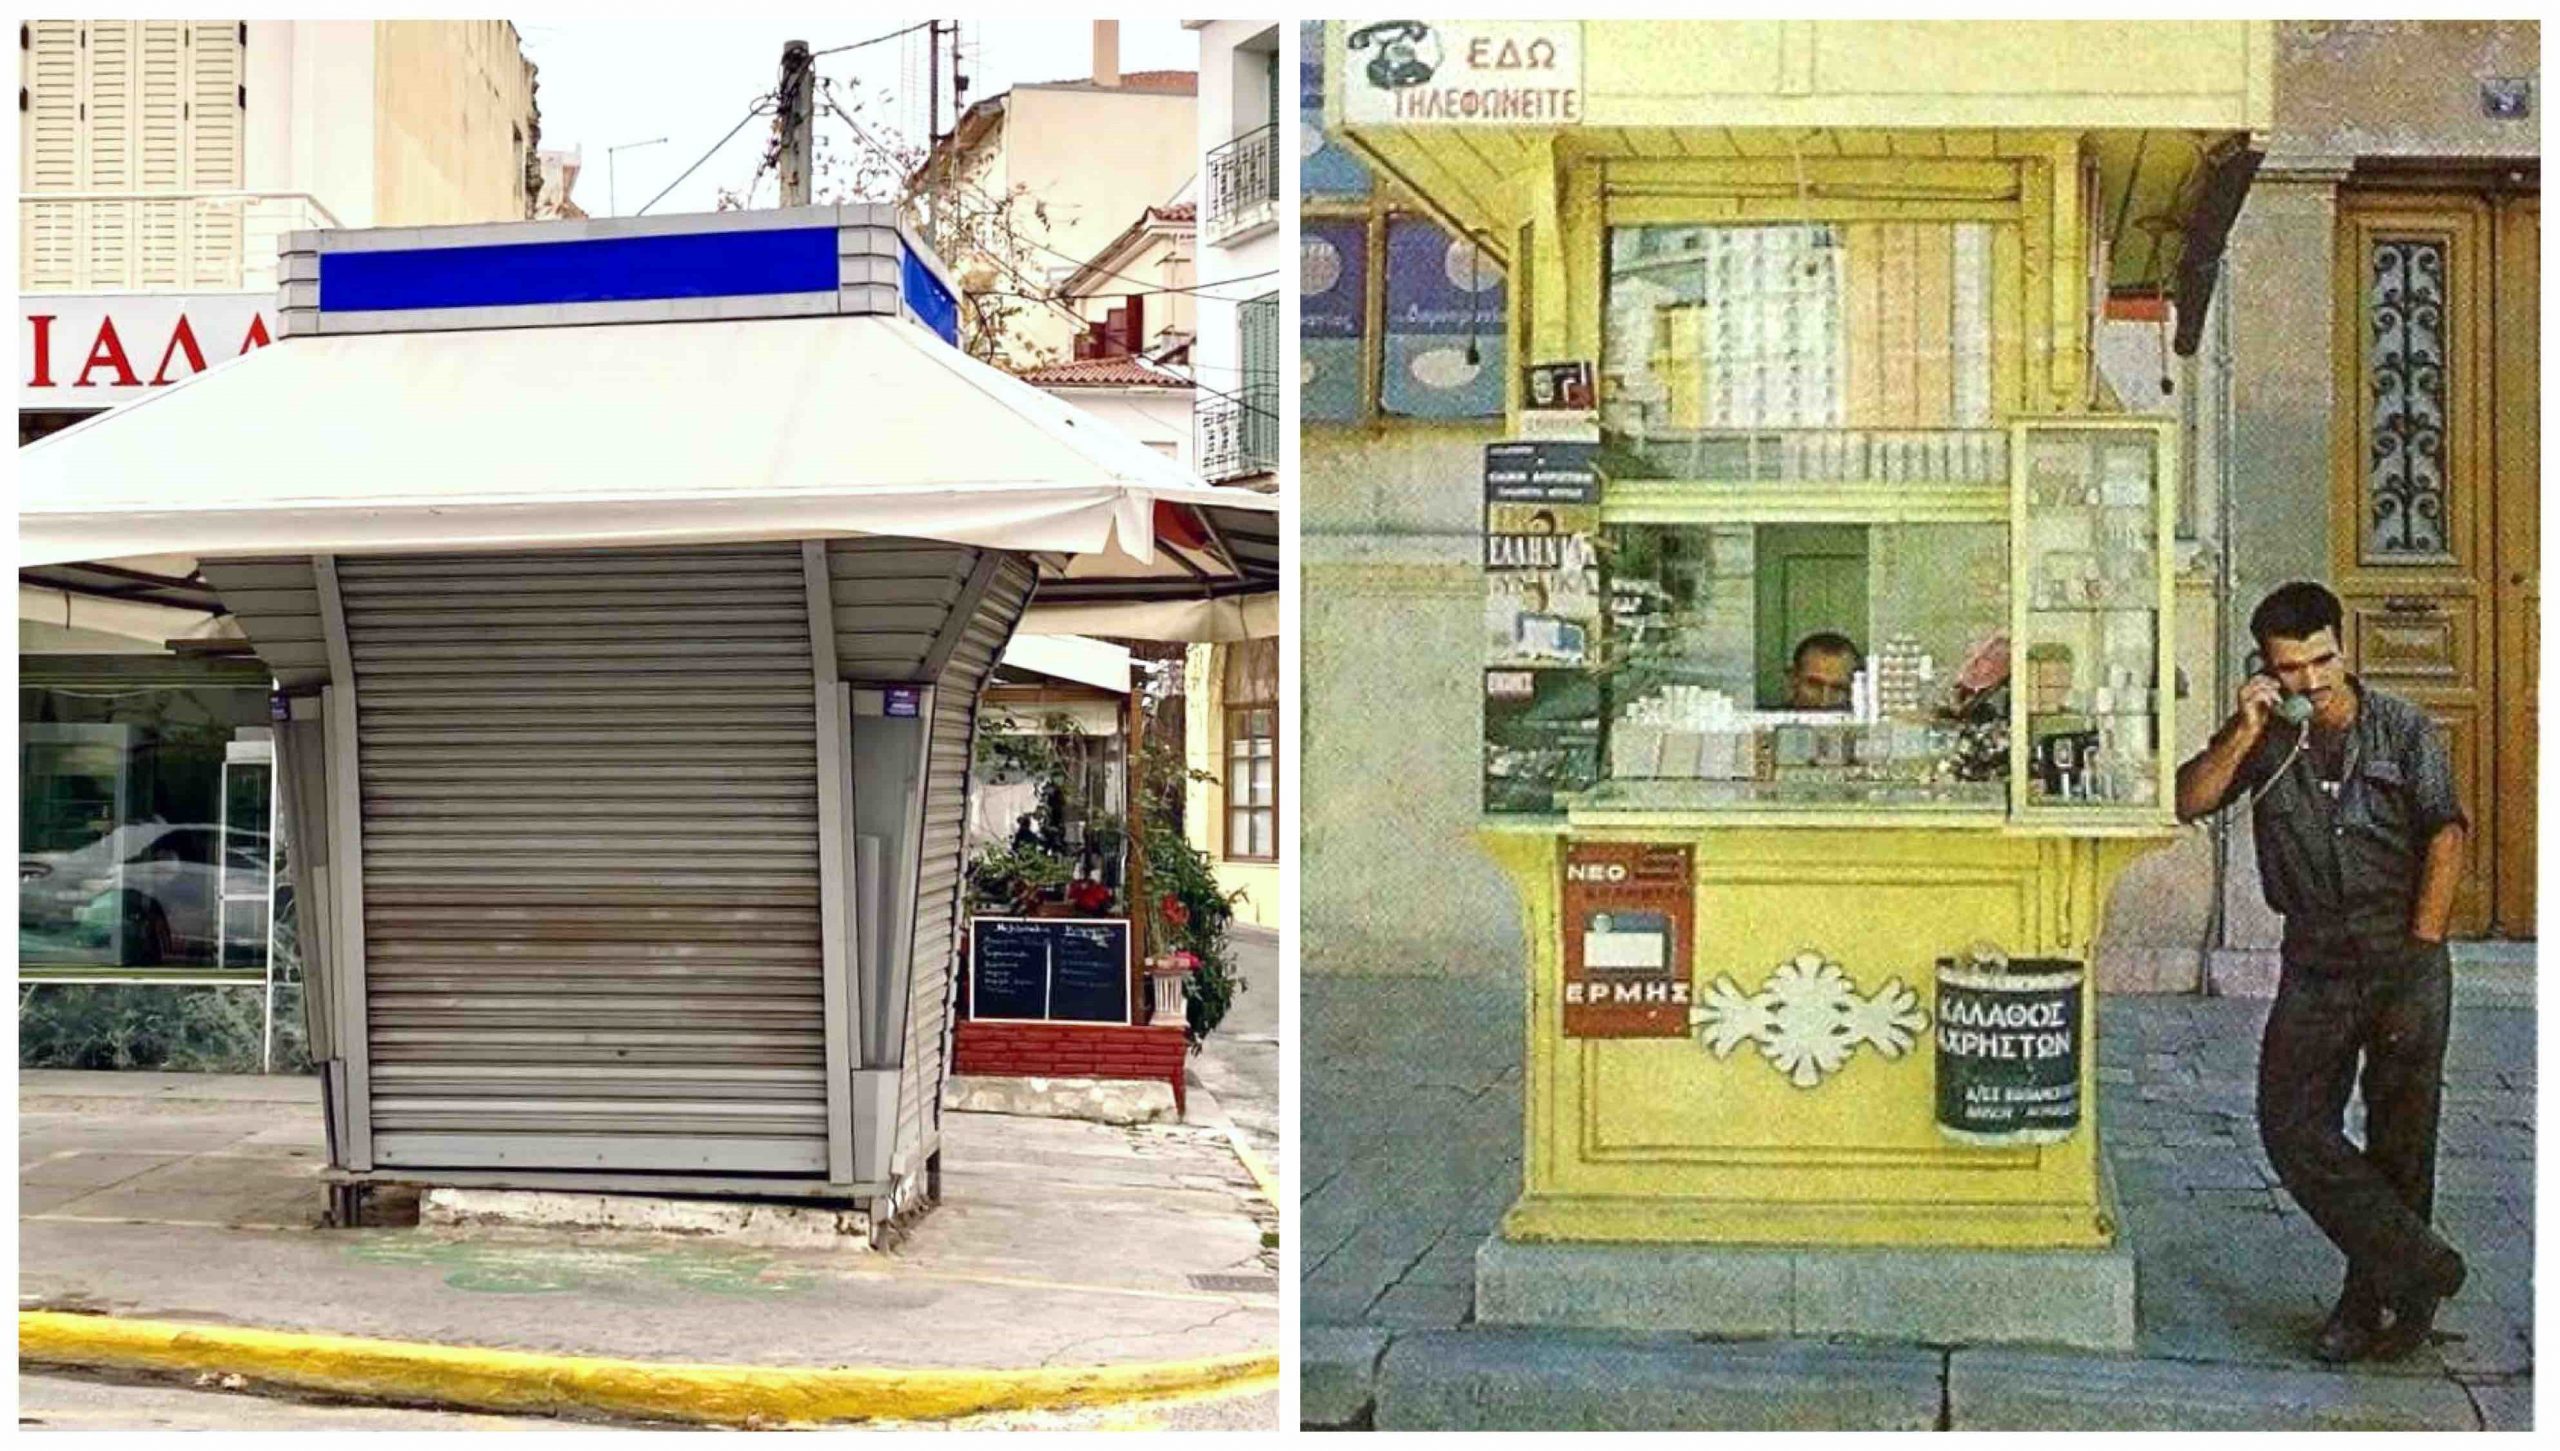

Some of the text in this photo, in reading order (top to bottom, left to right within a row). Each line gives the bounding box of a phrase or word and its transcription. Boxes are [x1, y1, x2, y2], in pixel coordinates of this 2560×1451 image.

[1467, 36, 1556, 69] ΕΔΩ
[1395, 88, 1577, 118] ΤΗΛΕΦΩΝΕΙΤΕ
[1567, 863, 1627, 882] ΝΕΟ
[1565, 981, 1690, 1004] ΕΡΜΗΣ
